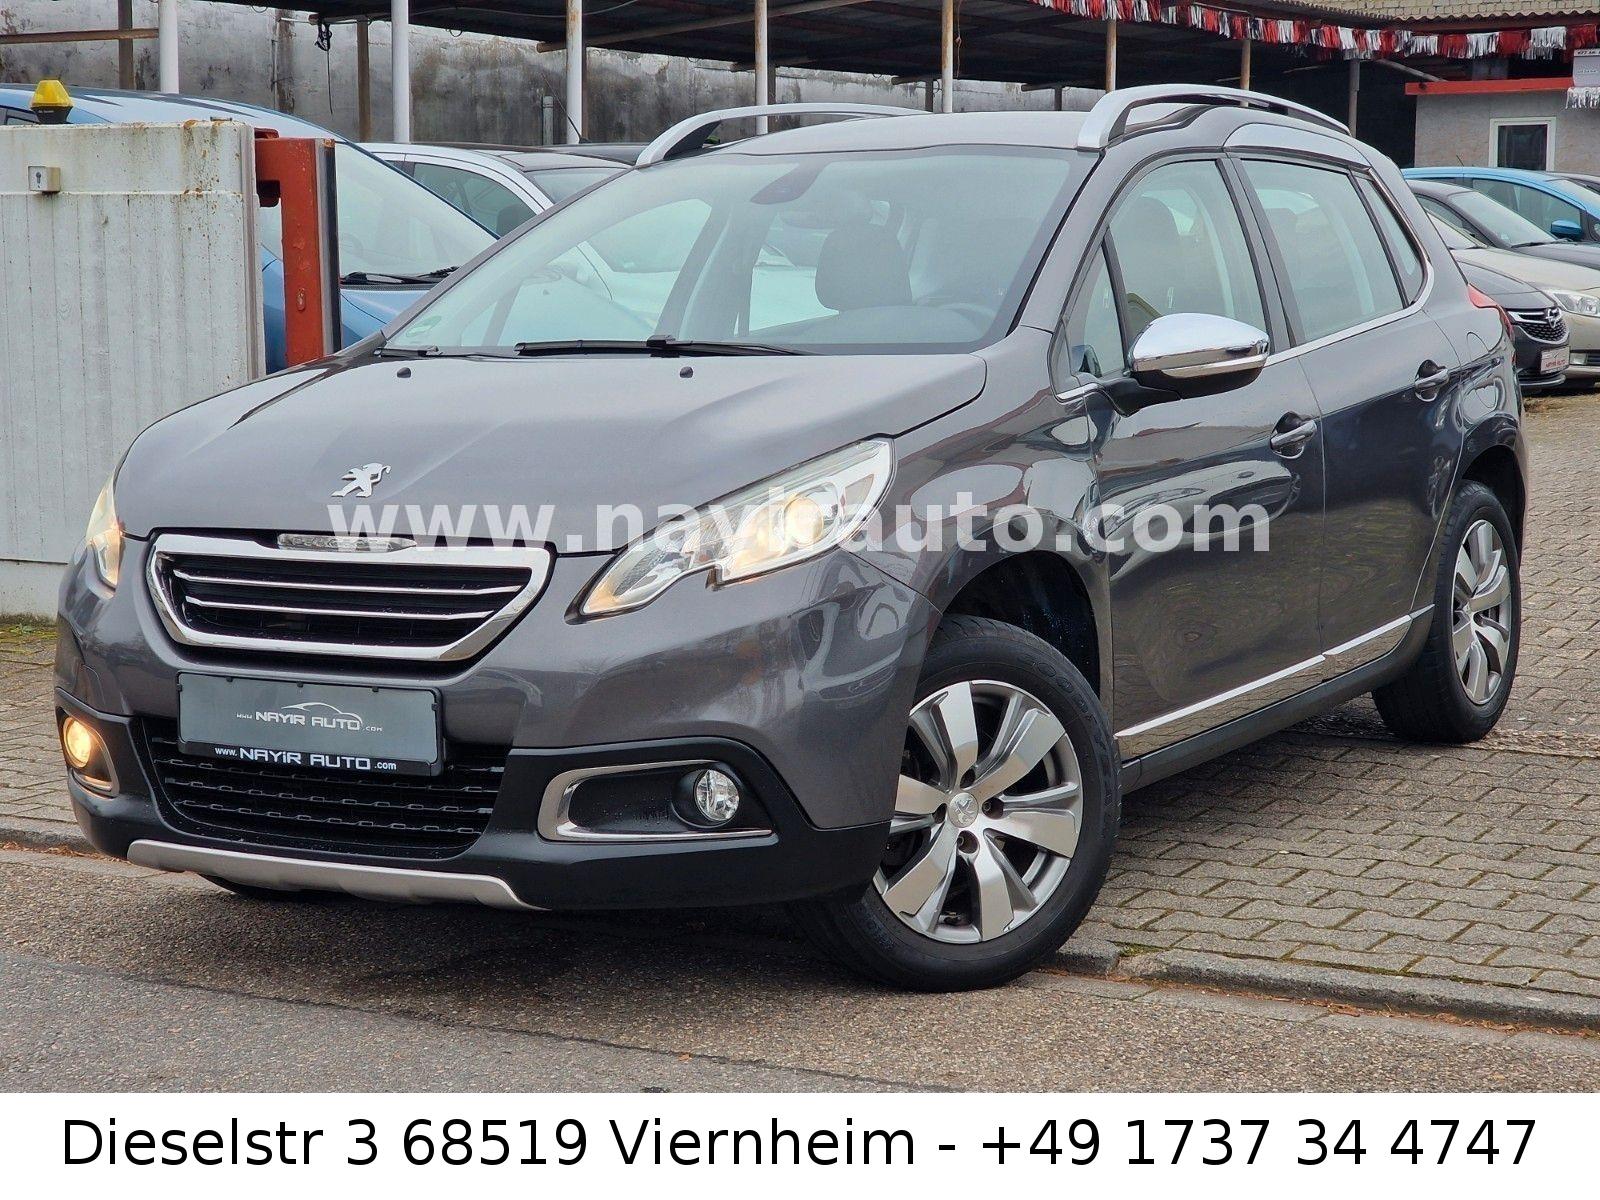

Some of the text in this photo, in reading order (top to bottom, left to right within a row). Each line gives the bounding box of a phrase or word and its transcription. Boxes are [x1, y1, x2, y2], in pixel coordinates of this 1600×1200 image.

[311, 716, 361, 731] AUTO
[214, 747, 238, 757] www.
[310, 754, 371, 770] AUTO
[374, 761, 397, 770] .com
